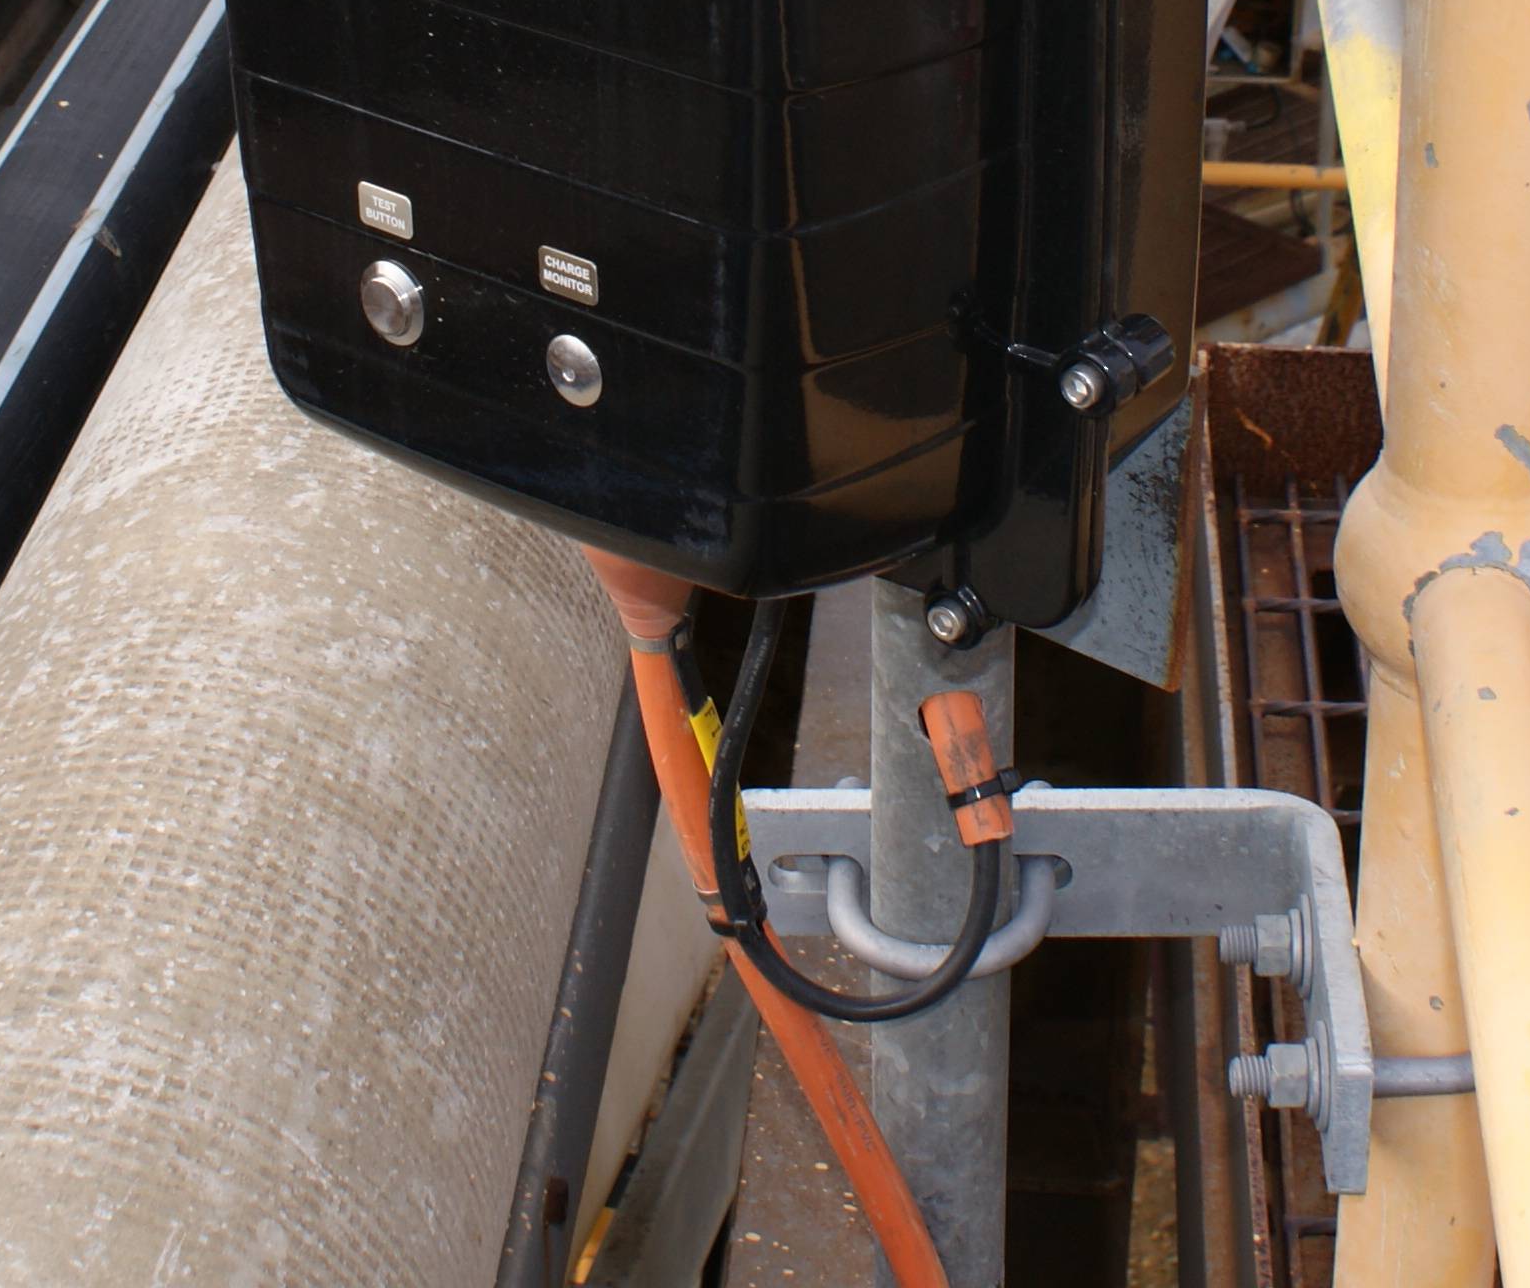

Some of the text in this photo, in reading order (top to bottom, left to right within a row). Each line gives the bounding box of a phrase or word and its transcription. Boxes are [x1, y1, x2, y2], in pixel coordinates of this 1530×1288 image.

[373, 196, 397, 213] TEST
[366, 207, 406, 230] BUTTON
[544, 255, 591, 281] CHARGE
[543, 268, 593, 297] MONITOR
